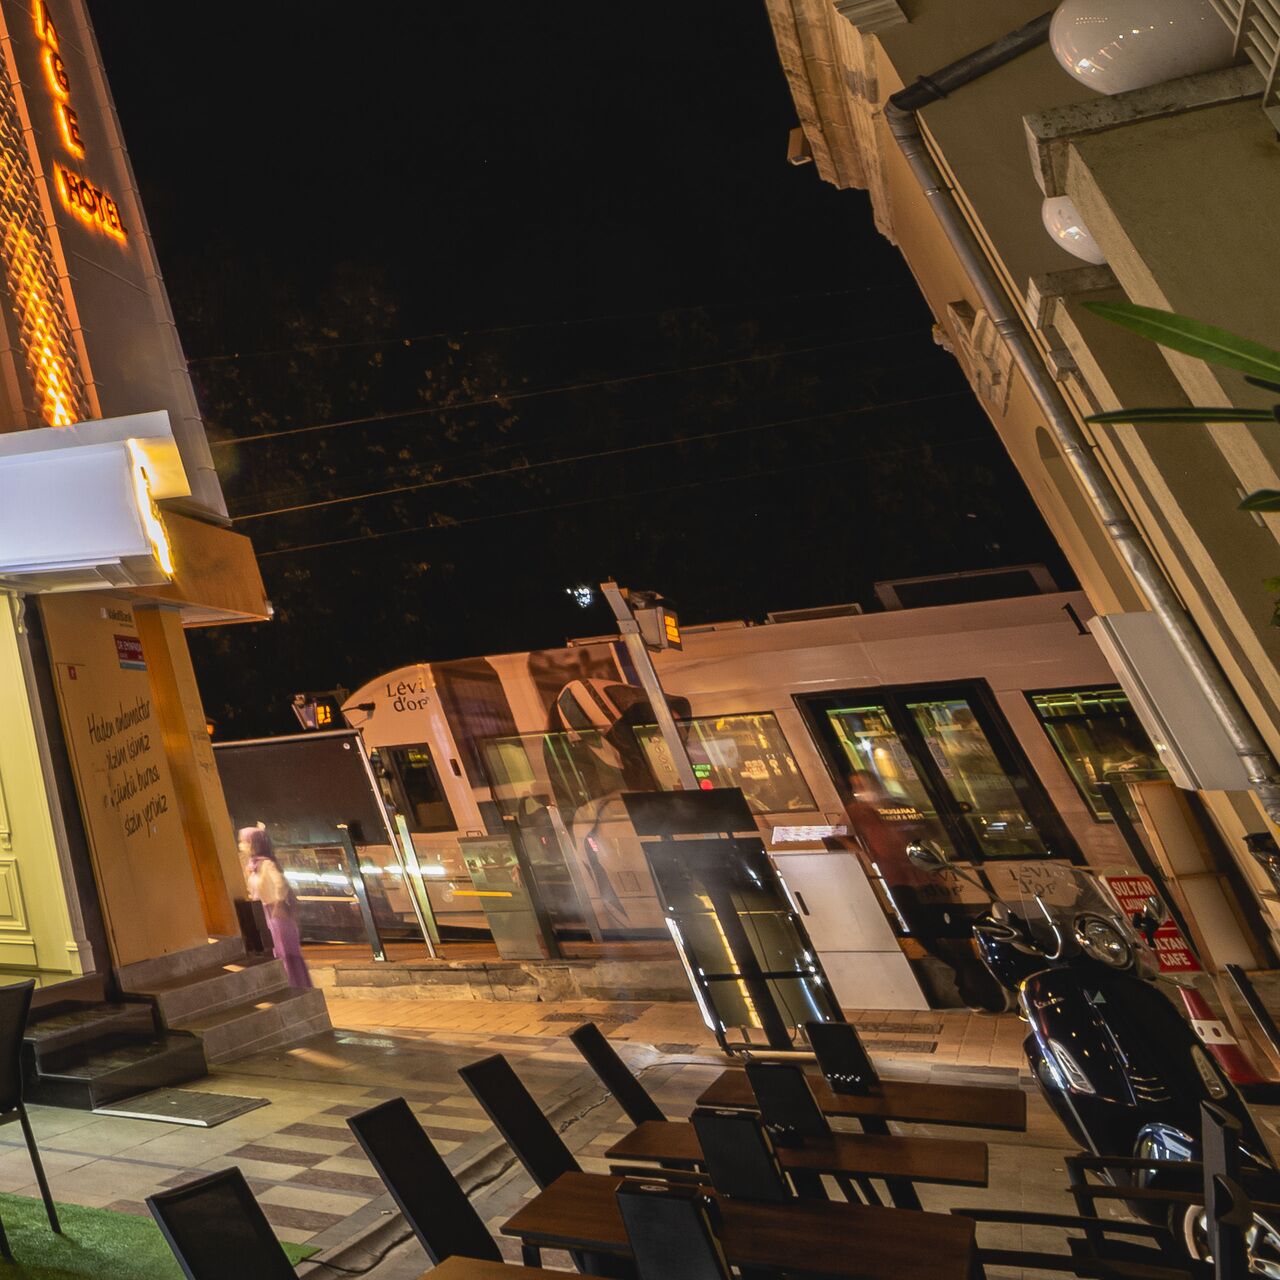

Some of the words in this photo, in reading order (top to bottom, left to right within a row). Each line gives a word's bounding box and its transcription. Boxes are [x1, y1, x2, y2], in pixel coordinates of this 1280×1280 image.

[53, 161, 128, 245] HOTEL
[1111, 880, 1156, 896] SULTAN
[1159, 953, 1192, 966] CAFE
